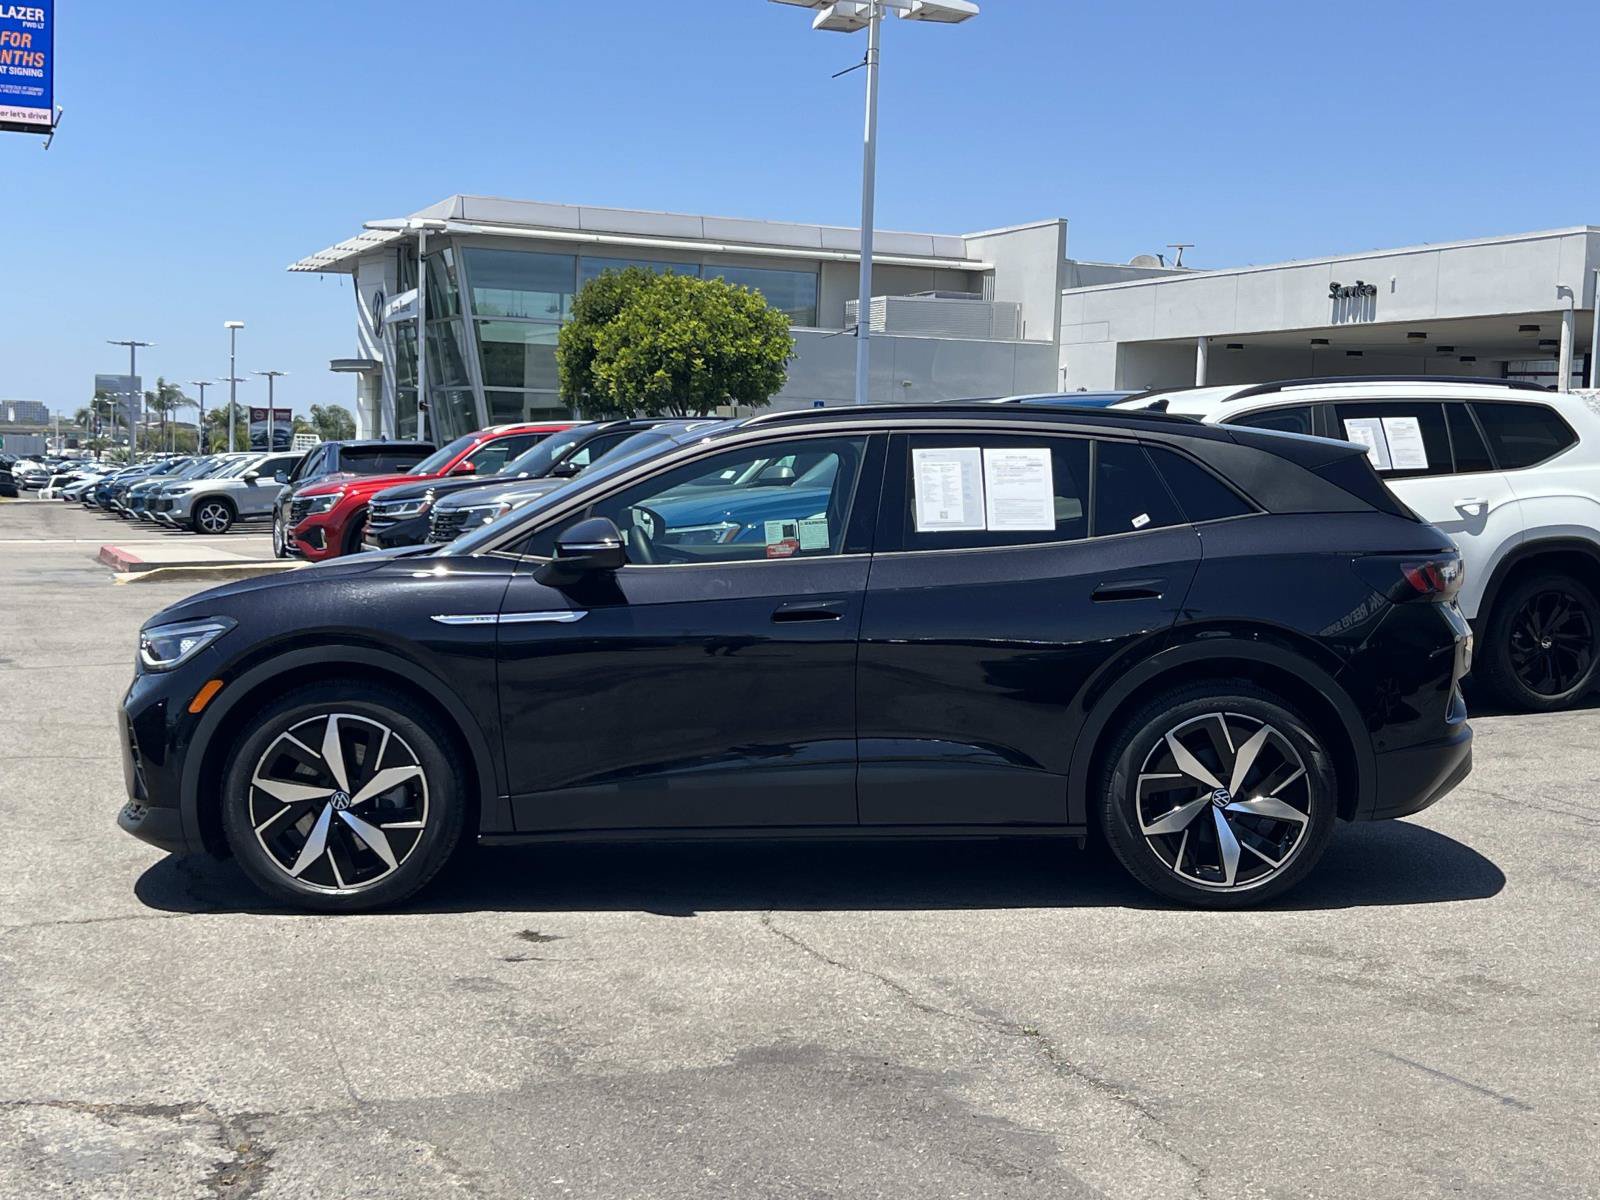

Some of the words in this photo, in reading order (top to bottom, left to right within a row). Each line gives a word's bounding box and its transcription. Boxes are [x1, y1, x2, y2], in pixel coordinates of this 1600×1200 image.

[0, 5, 45, 21] LAZER
[0, 31, 32, 48] FOR
[0, 49, 45, 67] NTHS
[8, 66, 44, 77] SIGNING
[10, 110, 26, 118] let's
[27, 112, 48, 120] drive
